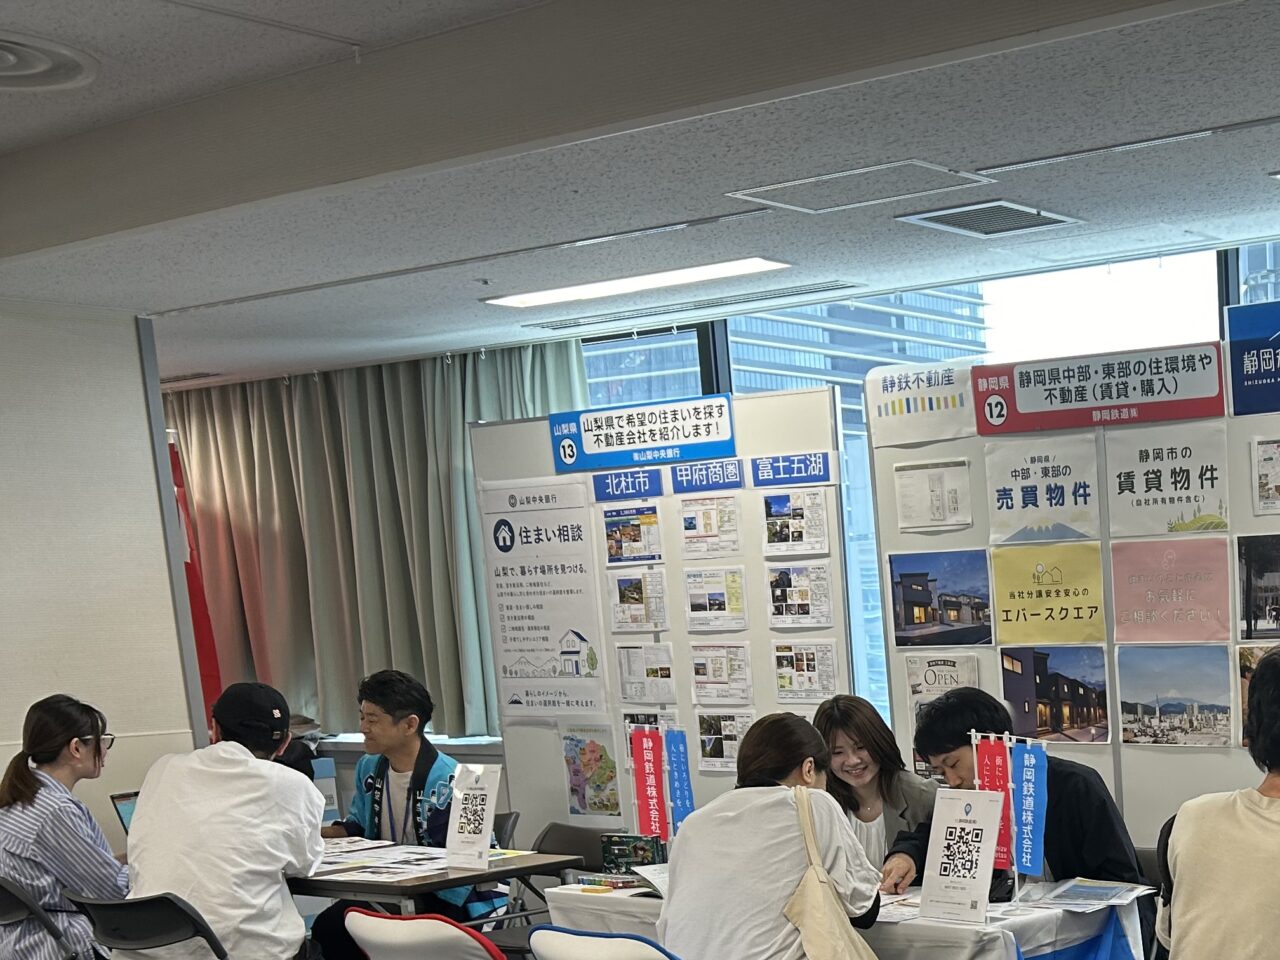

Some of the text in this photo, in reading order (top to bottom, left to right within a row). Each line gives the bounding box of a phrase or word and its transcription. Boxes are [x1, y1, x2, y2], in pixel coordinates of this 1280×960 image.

[881, 367, 955, 394] 静鉄不動産
[1018, 353, 1213, 389] 静岡県中部・東部の住環境や
[978, 375, 1010, 393] 静岡県
[583, 404, 726, 433] 山梨県で希望の住まいを探す
[987, 400, 1005, 420] 12
[553, 422, 578, 436] 山梨県
[593, 421, 720, 449] 不動産会社を紹介します！
[561, 444, 576, 460] 13
[1139, 446, 1193, 464] 静岡市の
[677, 460, 740, 488] 甲府商圏
[758, 454, 824, 481] 富士五湖
[1010, 465, 1072, 481] 中部・東部の
[1116, 464, 1219, 496] 賃貸物件
[605, 471, 650, 496] 北杜市
[996, 481, 1092, 511] 売買物件
[519, 523, 584, 546] 住まい相談
[1001, 604, 1099, 623] エバースクエア
[924, 668, 960, 686] OPEN
[1021, 752, 1037, 868] 静岡鉄道株式会社
